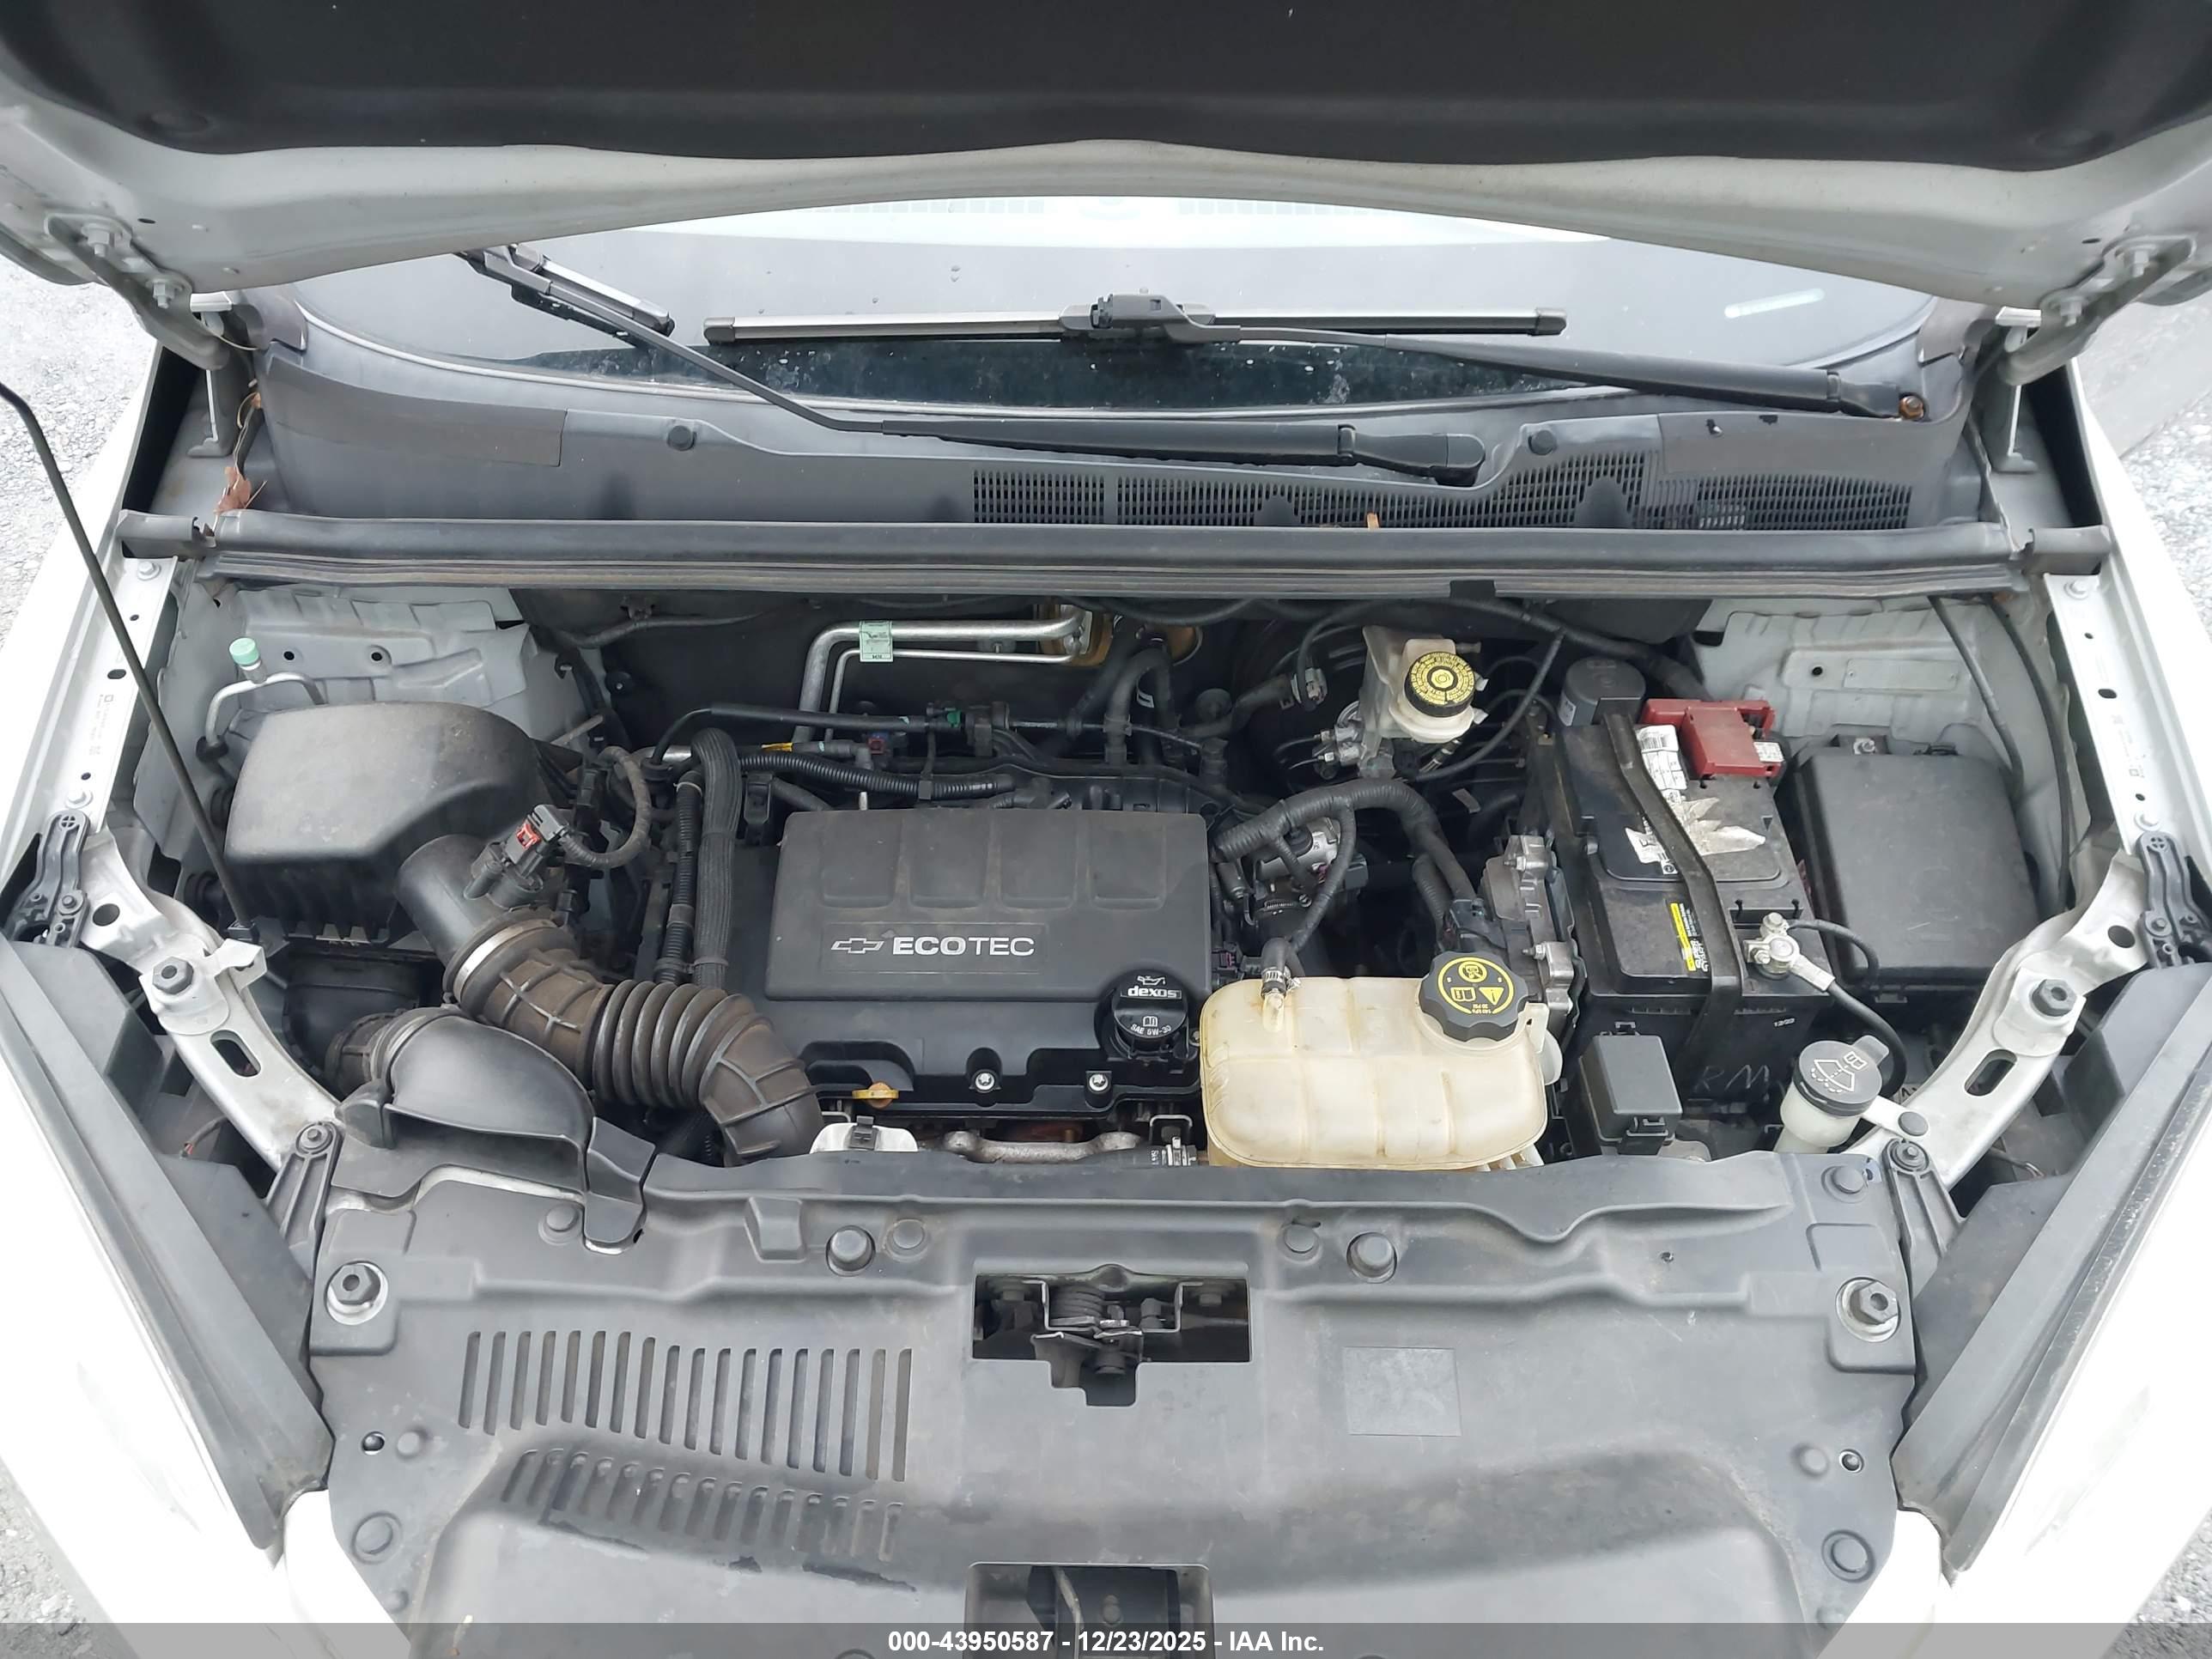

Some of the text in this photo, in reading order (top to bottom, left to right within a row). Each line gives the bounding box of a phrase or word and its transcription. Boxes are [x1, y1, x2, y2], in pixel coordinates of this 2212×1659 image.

[893, 937, 1035, 956] ECOTEC
[1127, 985, 1177, 999] dexos
[1131, 1024, 1172, 1036] SAE 5W-30
